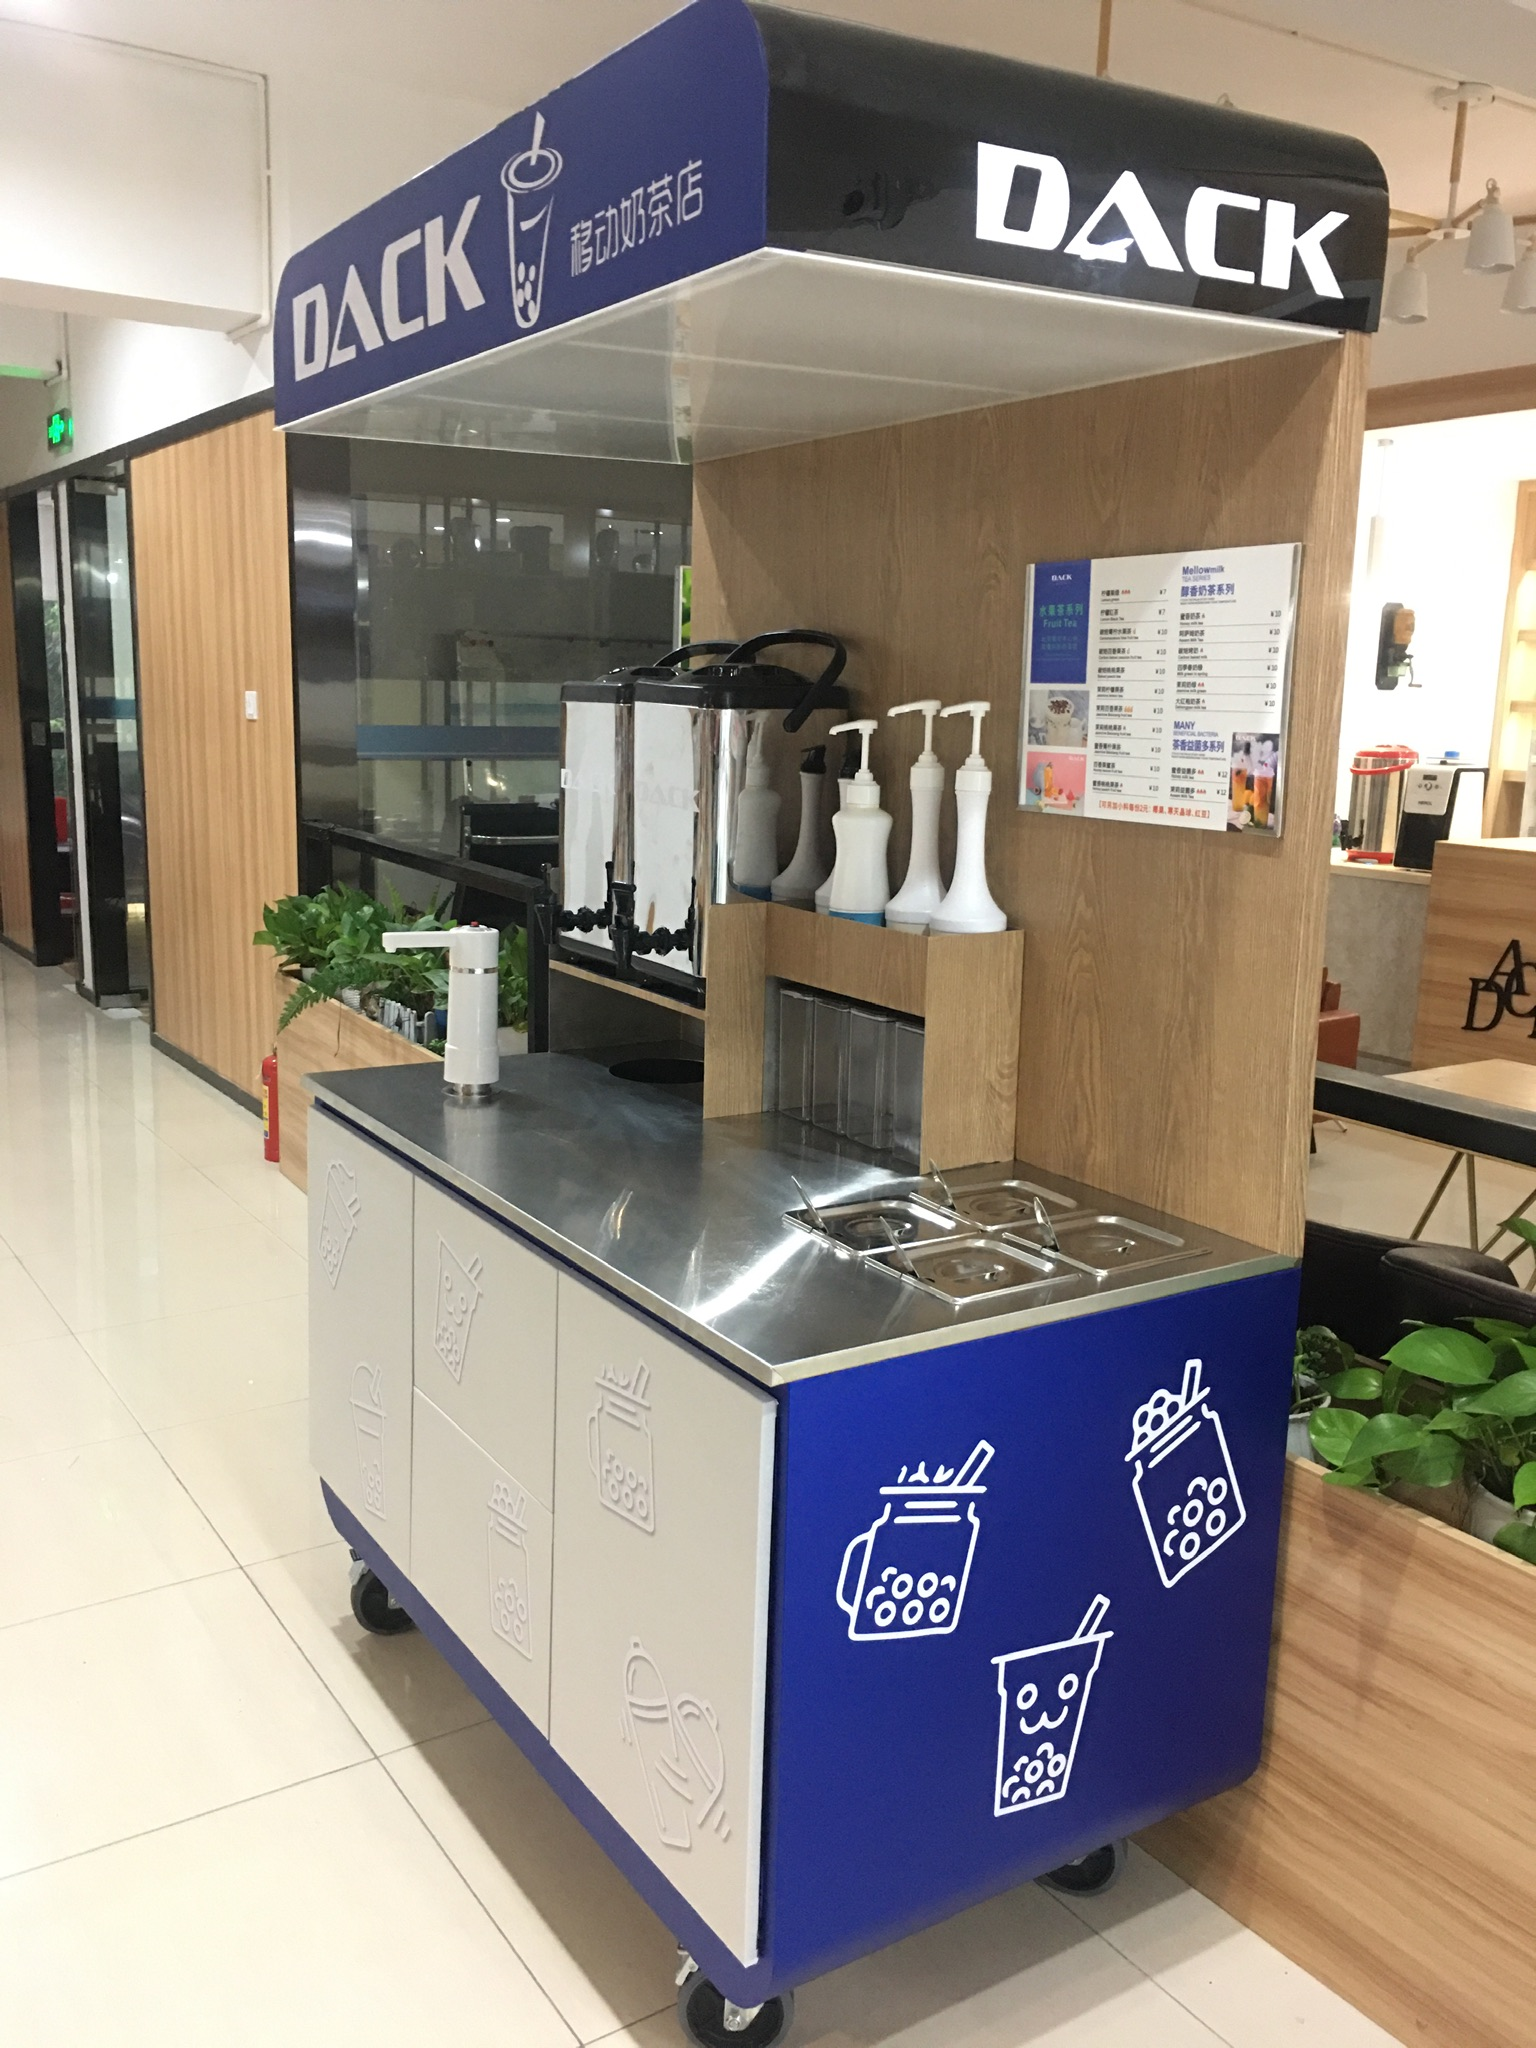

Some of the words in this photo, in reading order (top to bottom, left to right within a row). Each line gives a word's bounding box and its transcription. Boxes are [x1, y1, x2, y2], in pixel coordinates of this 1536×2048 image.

[570, 159, 704, 278] 移动奶茶店
[975, 141, 1350, 299] DACK
[292, 195, 486, 382] DACK
[1182, 565, 1224, 575] Mellowmilk
[1181, 583, 1234, 597] 醇香奶茶系列
[1043, 619, 1062, 628] Fruit
[1064, 618, 1077, 627] Tea
[1174, 721, 1195, 730] MANY
